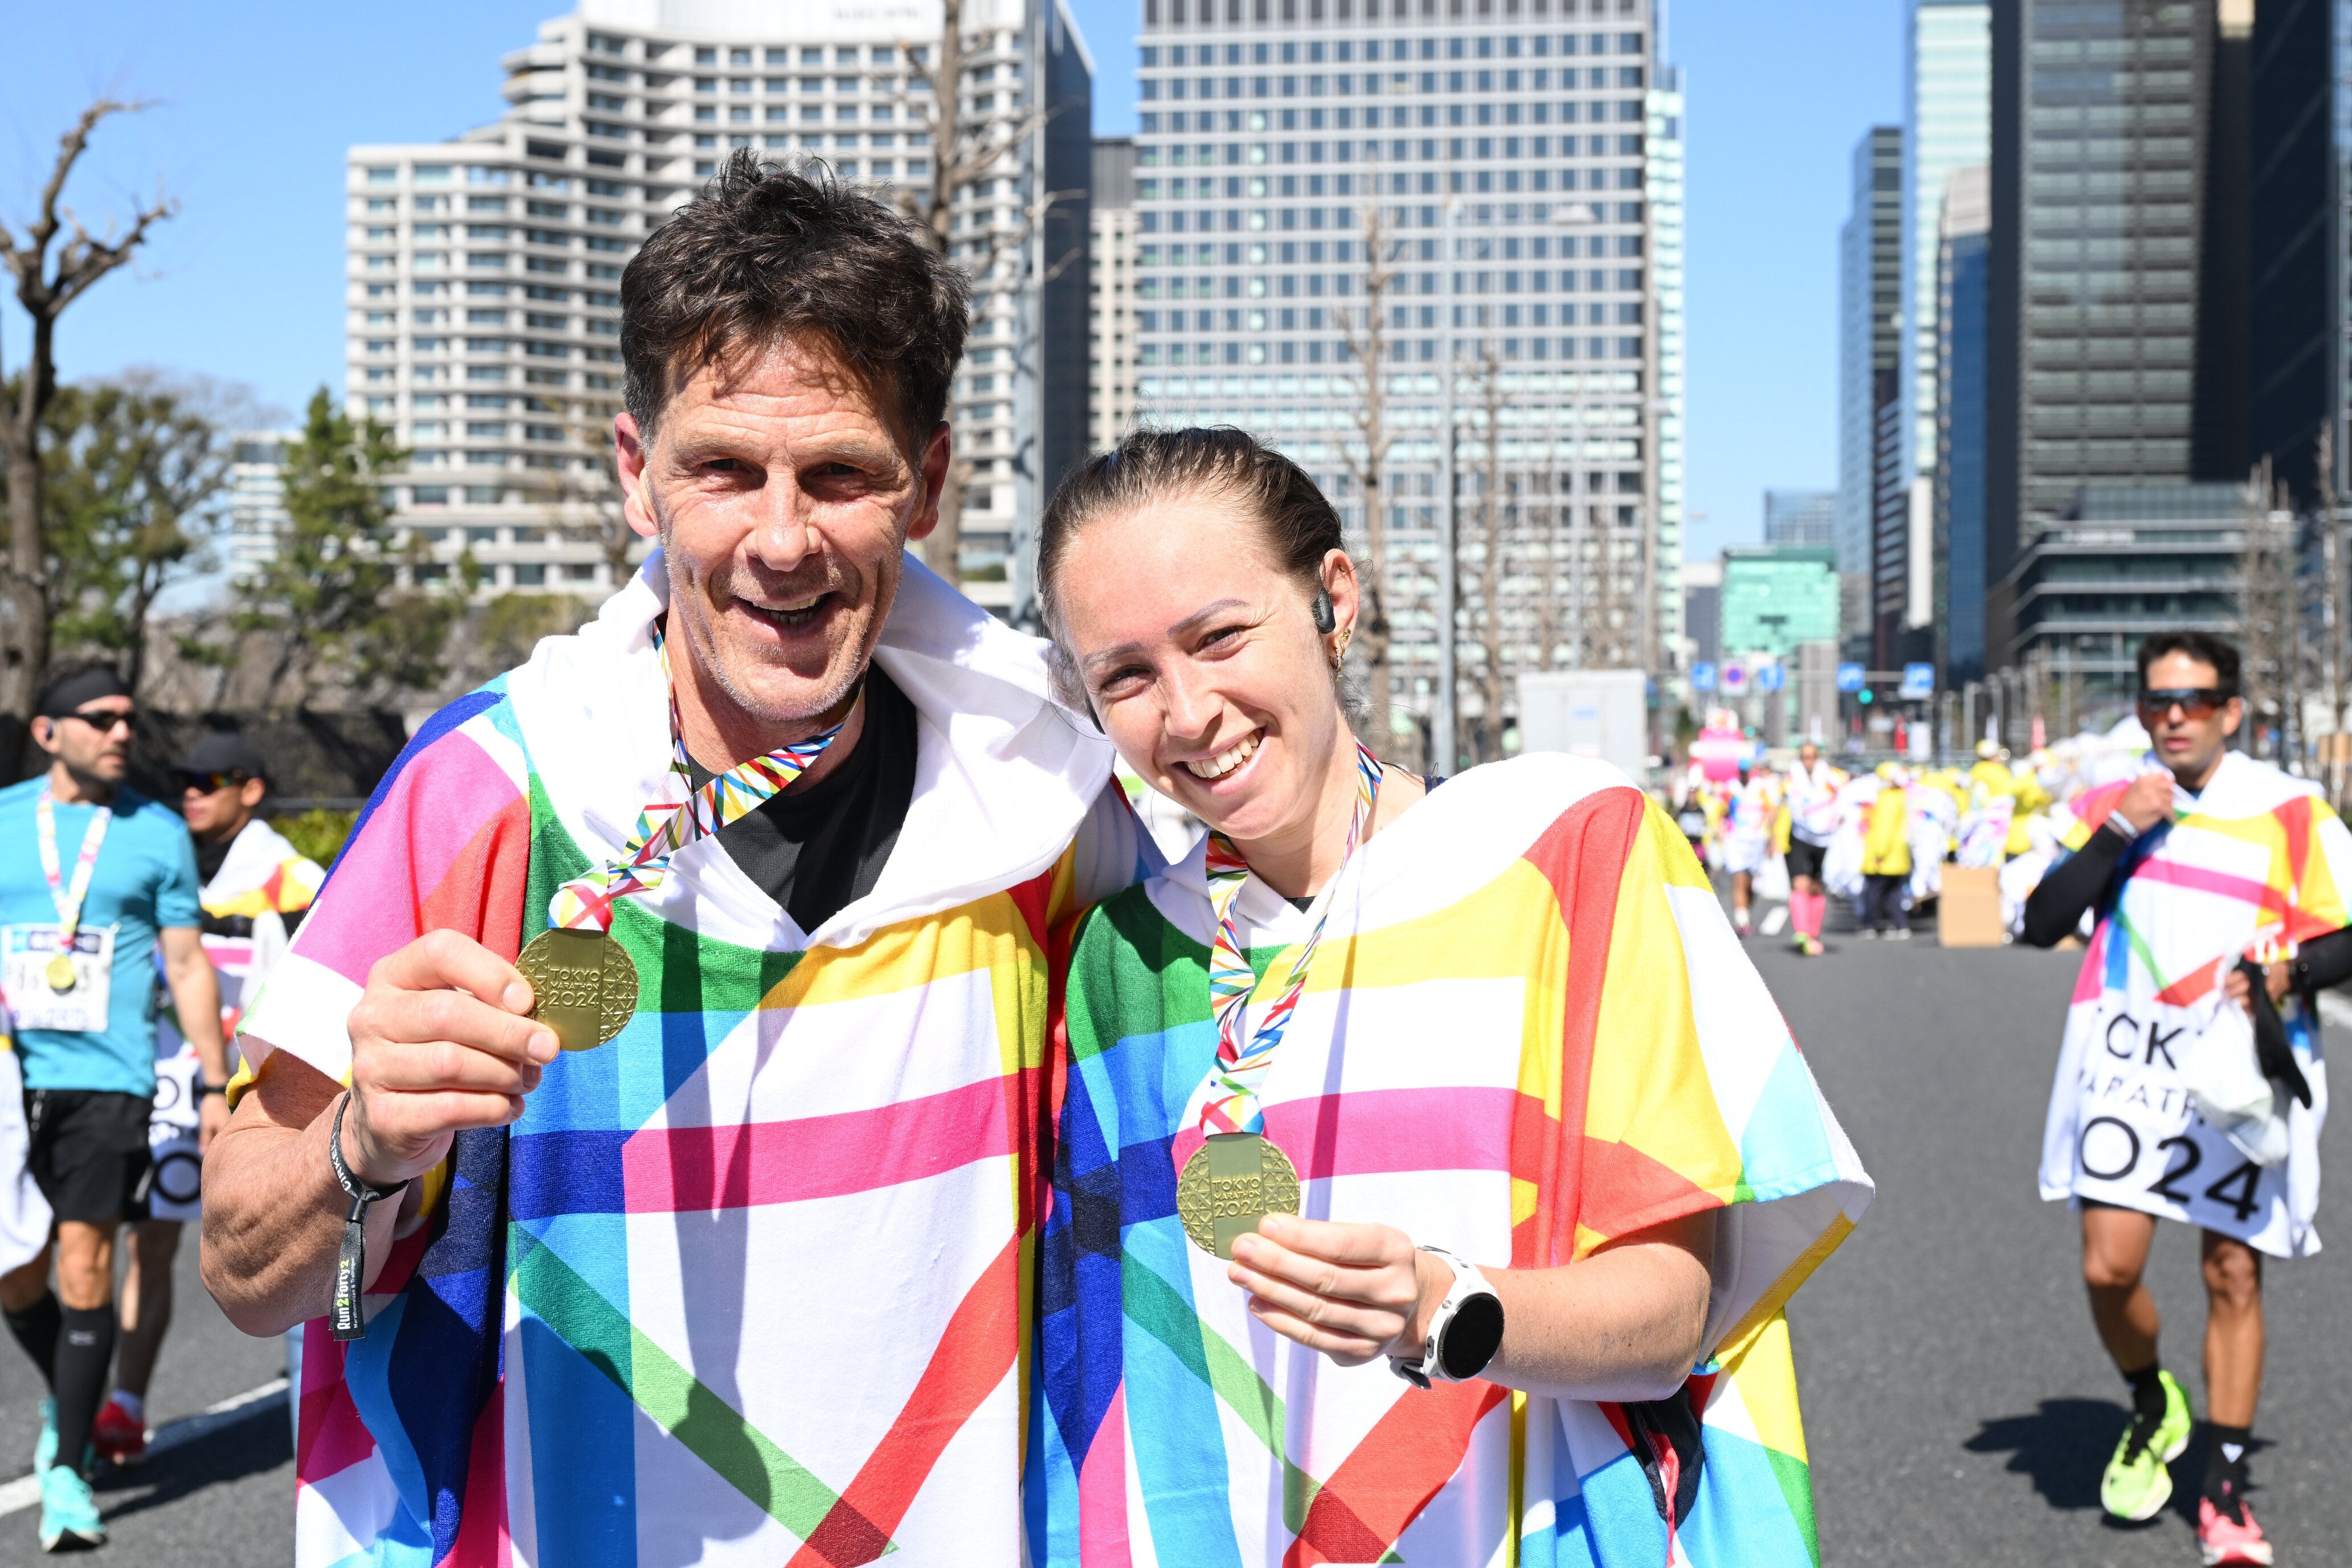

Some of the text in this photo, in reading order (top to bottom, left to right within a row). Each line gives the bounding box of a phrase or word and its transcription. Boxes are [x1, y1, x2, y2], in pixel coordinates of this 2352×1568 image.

[550, 968, 601, 982] TOKYO
[550, 981, 599, 991] MARATHON
[548, 990, 599, 1008] 2024
[1212, 1177, 1261, 1191] TOKYO
[1214, 1190, 1261, 1202] MARATHON
[1214, 1198, 1263, 1218] 2024
